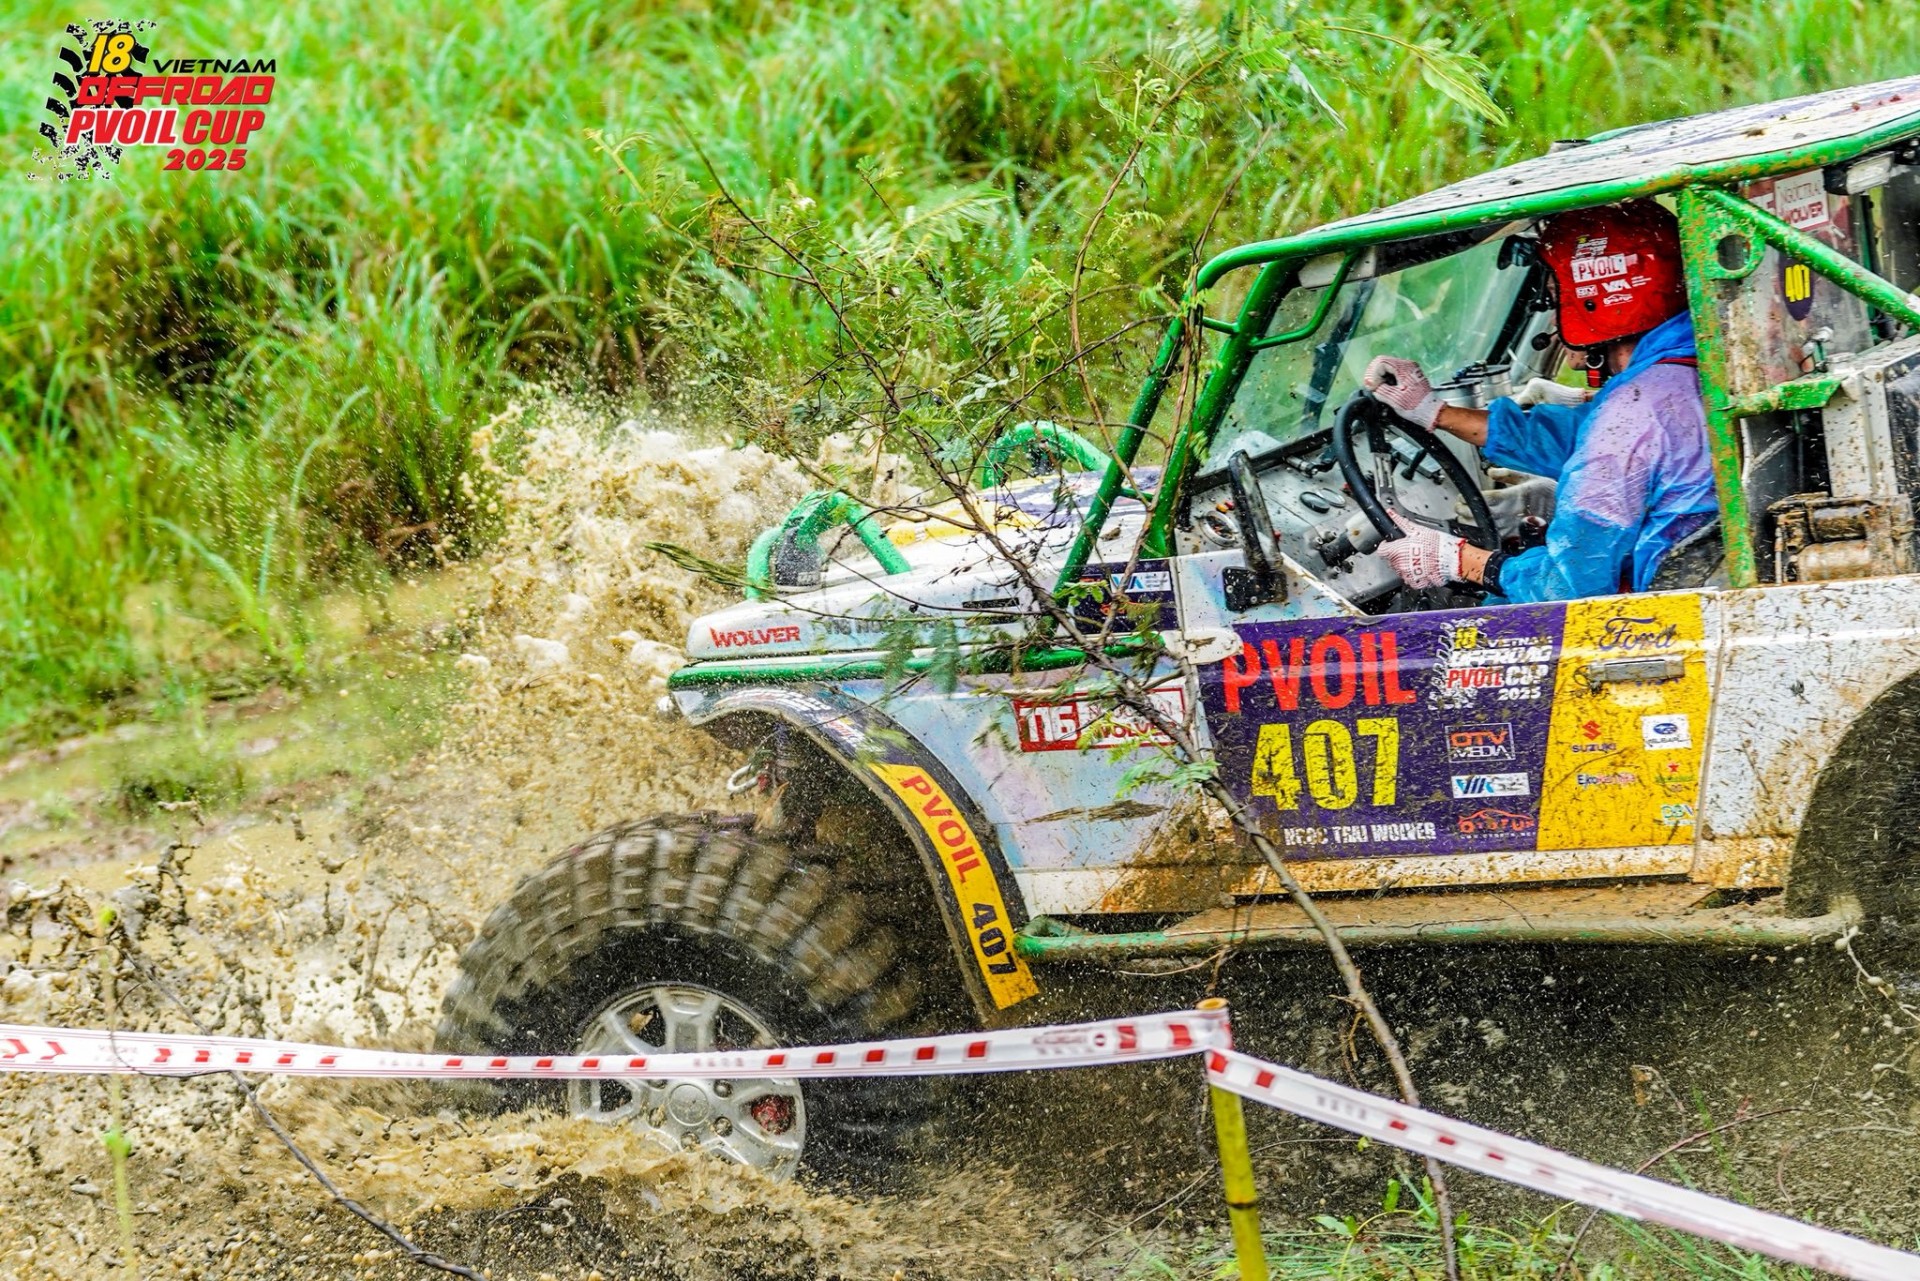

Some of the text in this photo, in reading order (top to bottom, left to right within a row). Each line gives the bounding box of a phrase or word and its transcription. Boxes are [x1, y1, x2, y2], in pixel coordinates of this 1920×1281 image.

[1578, 257, 1621, 280] PVOIL
[709, 625, 801, 648] WOLVER
[1599, 617, 1677, 651] Ford
[1223, 631, 1418, 713] PVOIL
[1446, 666, 1505, 689] PVOIL
[1498, 686, 1542, 701] 2025
[1252, 716, 1400, 812] 407
[900, 774, 981, 883] PVOIL
[972, 901, 1018, 975] 407
